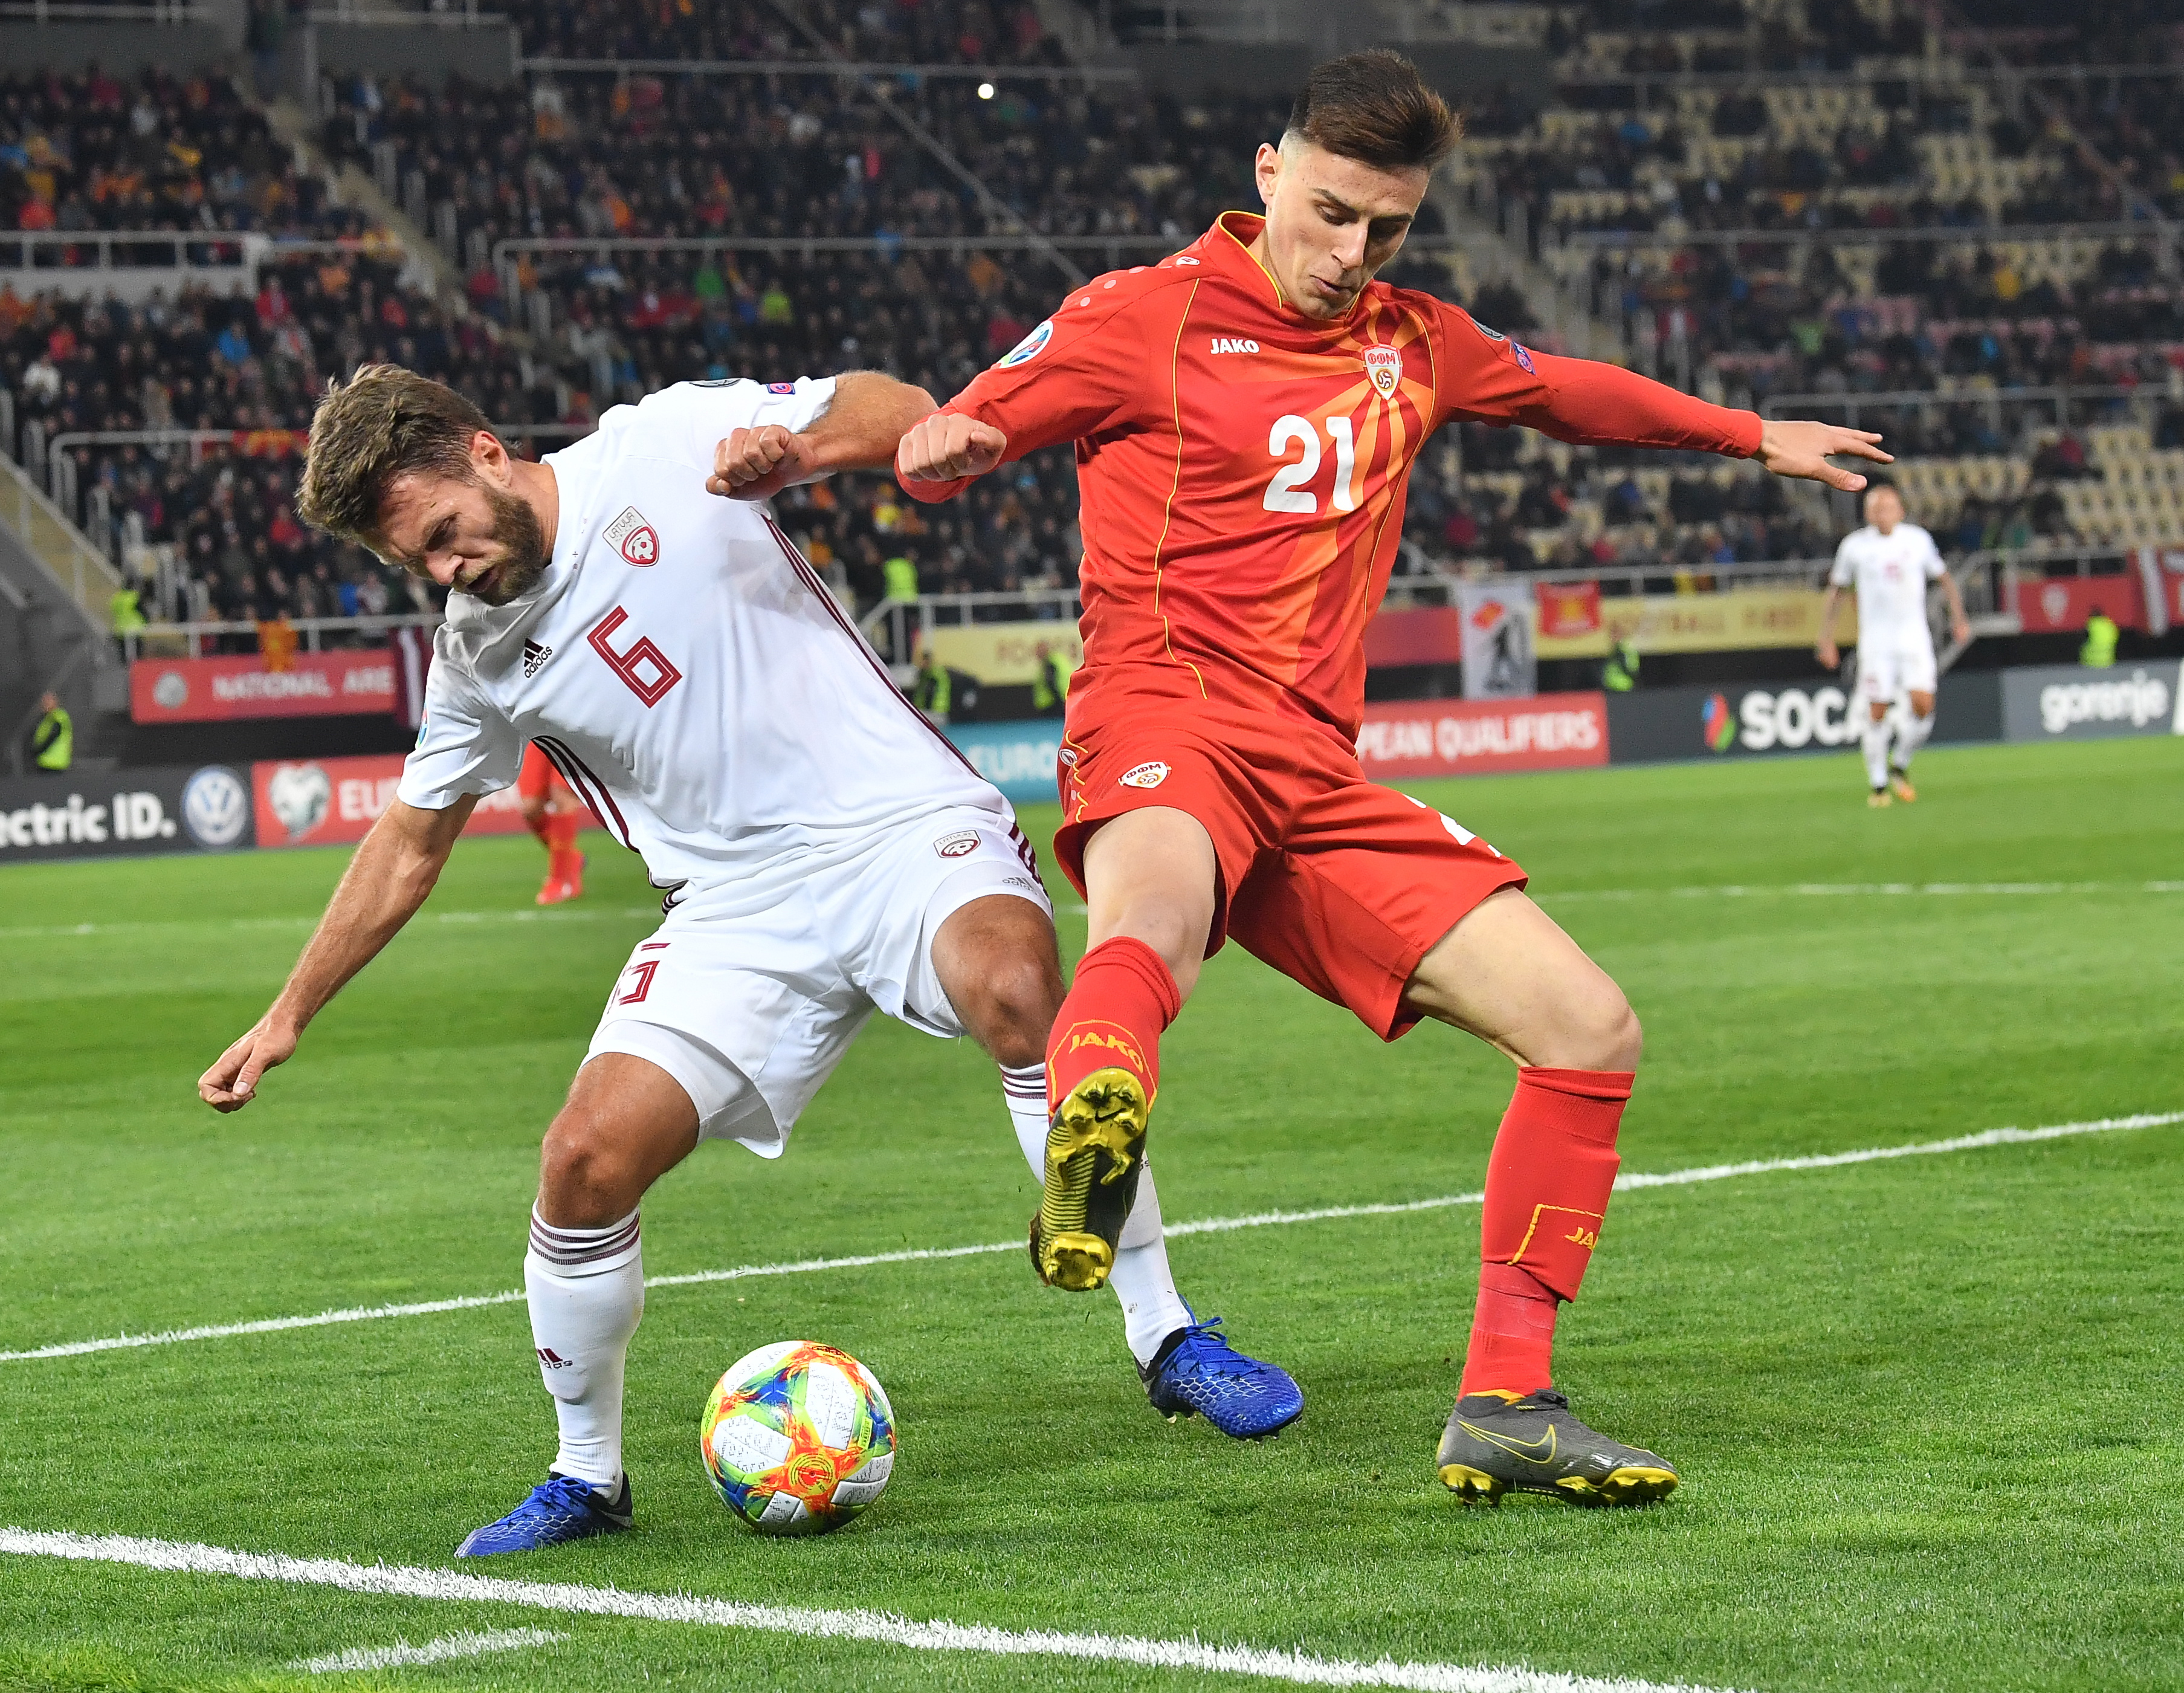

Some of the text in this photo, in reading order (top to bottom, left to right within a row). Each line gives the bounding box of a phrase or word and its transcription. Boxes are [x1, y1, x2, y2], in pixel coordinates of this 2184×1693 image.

[1210, 338, 1259, 354] JAKO
[1263, 415, 1355, 514] 21
[524, 646, 553, 678] adidas
[586, 605, 683, 708] 6
[212, 666, 396, 700] NATIONAL ARE
[1435, 709, 1600, 763] QUALIFIERS
[112, 791, 177, 840] ID.
[1068, 1031, 1144, 1073] JAKO
[1563, 1226, 1599, 1251] JA
